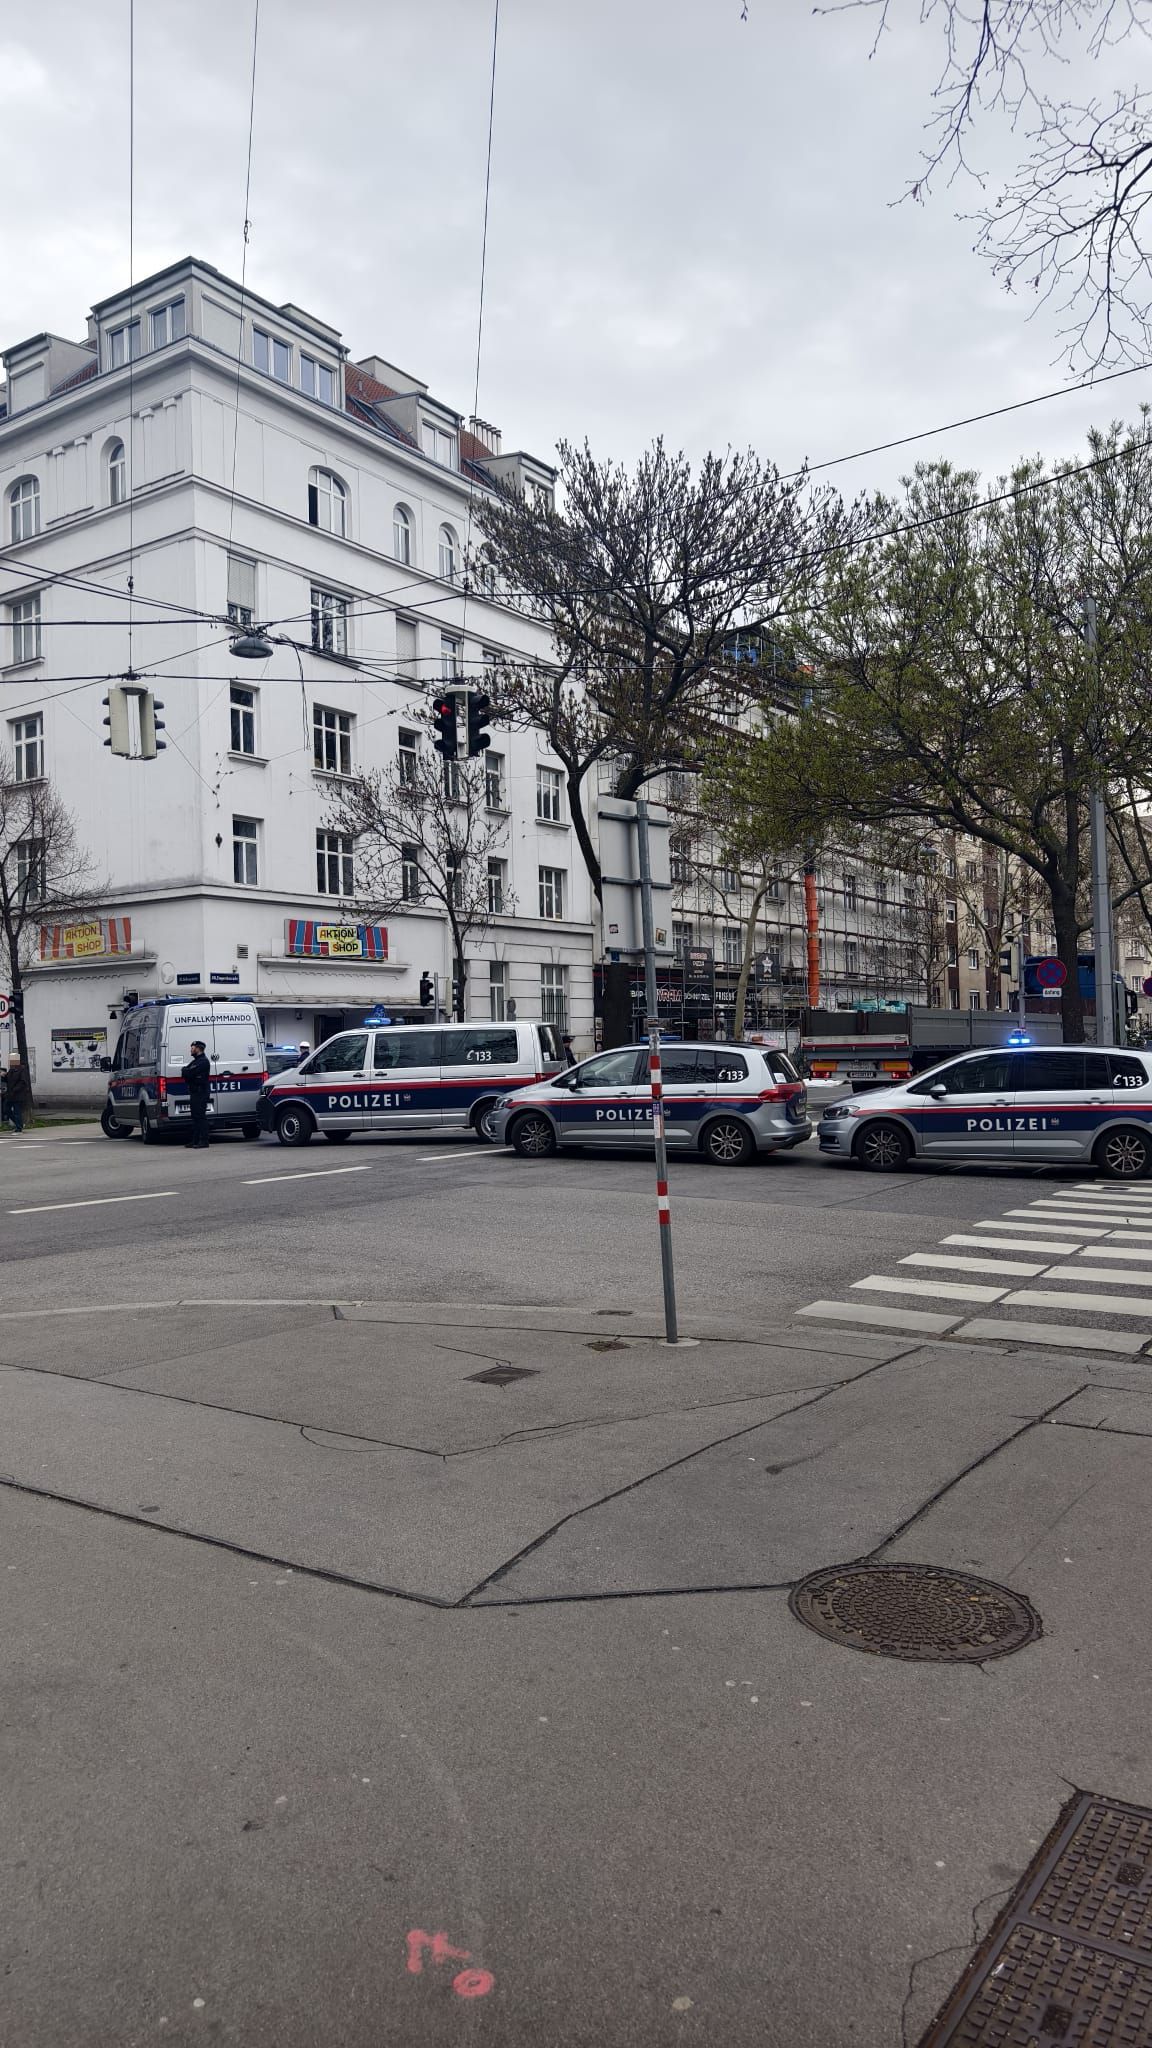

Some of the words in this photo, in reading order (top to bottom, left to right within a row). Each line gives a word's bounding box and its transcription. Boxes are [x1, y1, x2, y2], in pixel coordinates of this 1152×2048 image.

[65, 926, 97, 940] AKTION
[320, 929, 354, 938] AKTION
[77, 940, 101, 952] SHOP
[333, 943, 358, 952] SHOP
[174, 1014, 252, 1024] UNFALLKOMMANDO
[474, 1051, 492, 1062] 133
[726, 1071, 744, 1081] 133
[1122, 1075, 1143, 1087] 133
[209, 1081, 241, 1092] LIZEI
[328, 1093, 400, 1109] POLIZEI
[595, 1108, 653, 1121] POLIZE
[966, 1117, 1047, 1131] POLIZEI
